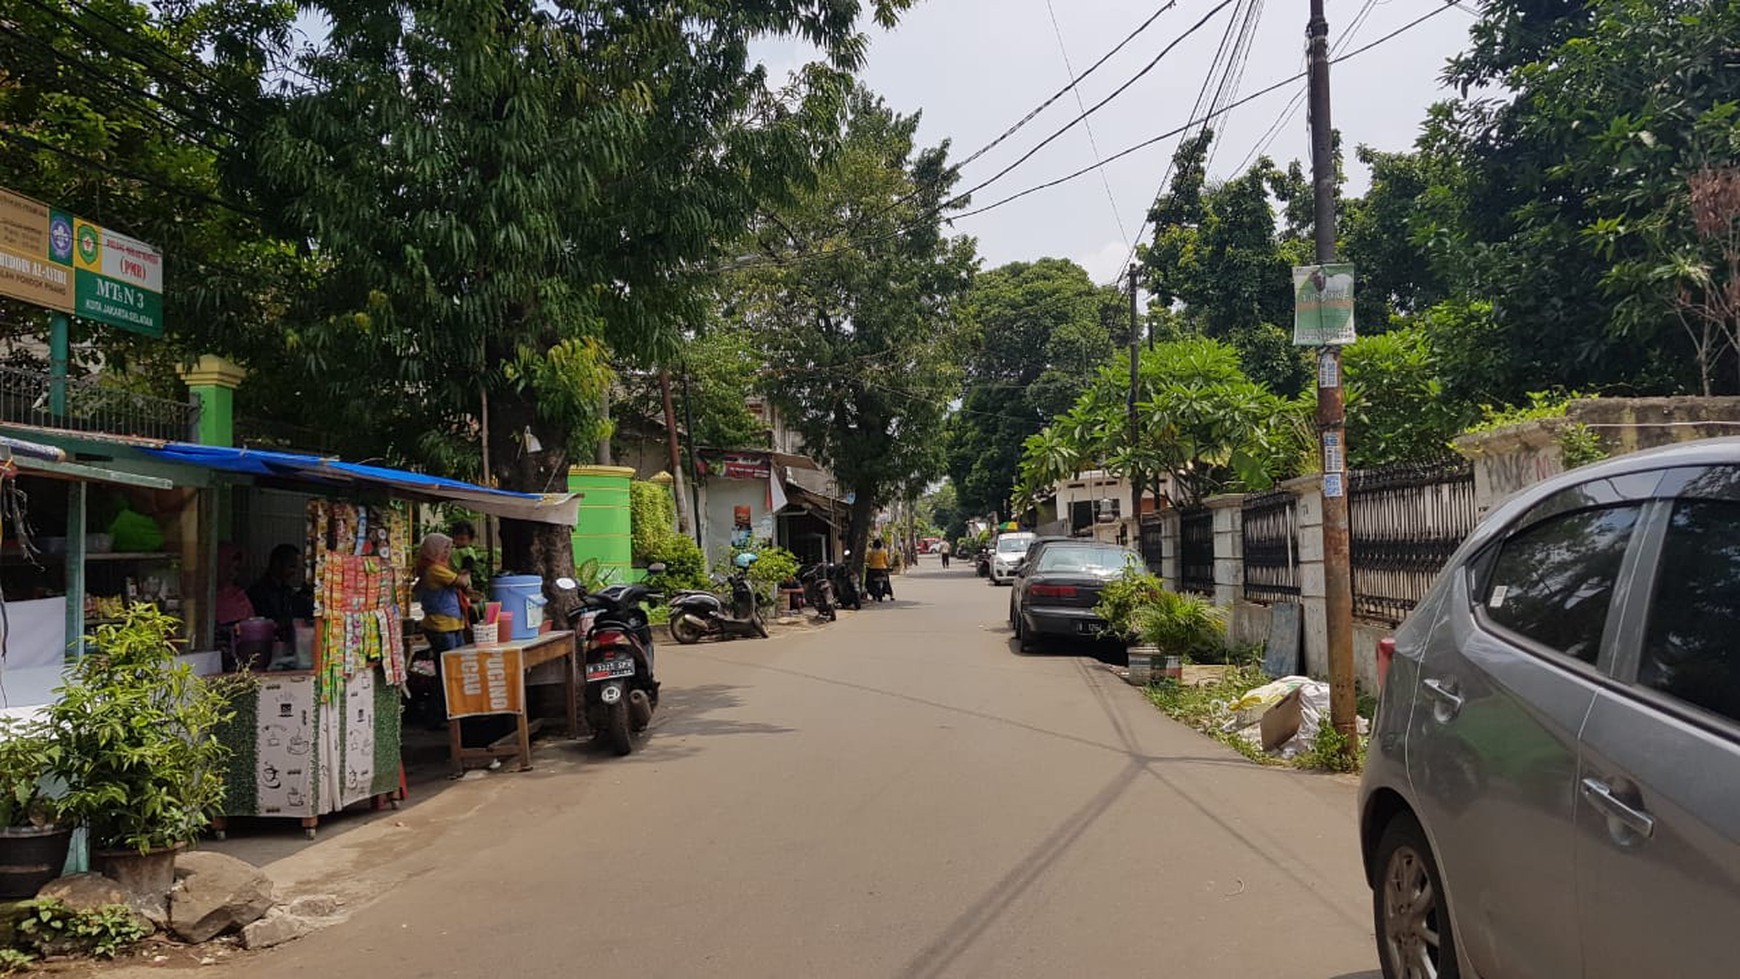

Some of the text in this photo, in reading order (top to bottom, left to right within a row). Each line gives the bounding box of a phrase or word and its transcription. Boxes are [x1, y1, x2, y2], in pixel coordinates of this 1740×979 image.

[96, 278, 145, 309] MTsN 3
[103, 304, 129, 319] JAKARTA
